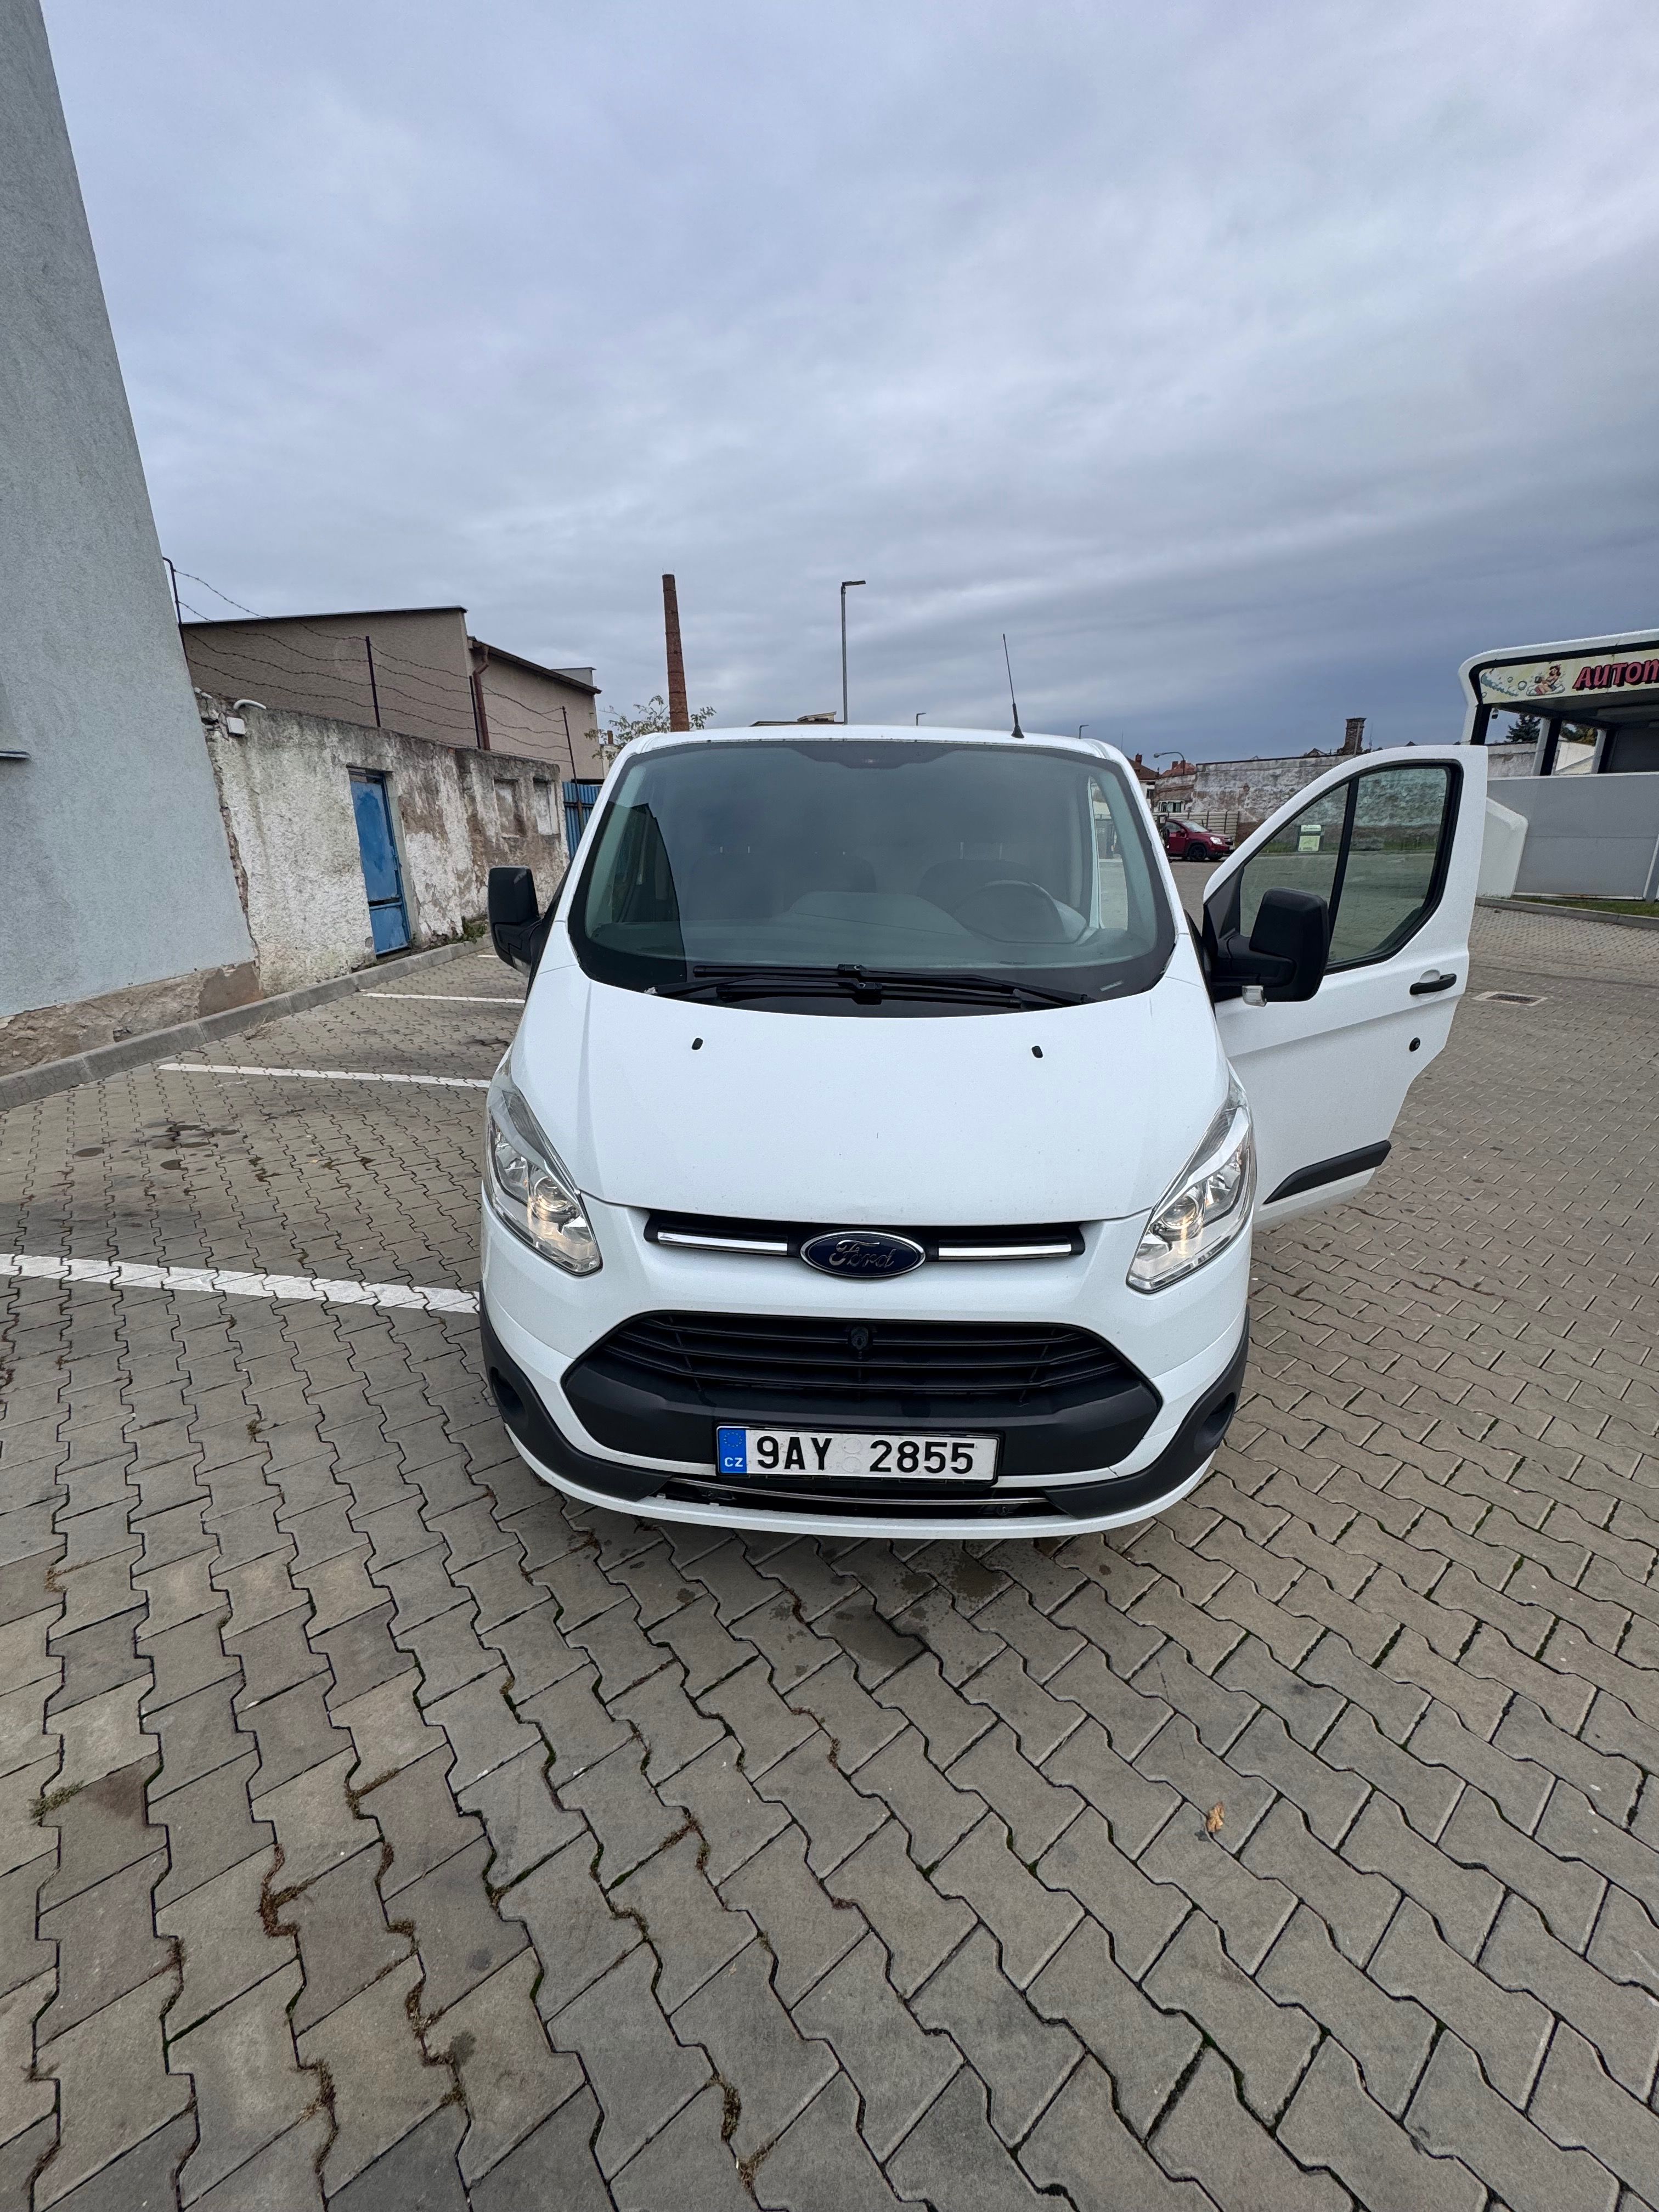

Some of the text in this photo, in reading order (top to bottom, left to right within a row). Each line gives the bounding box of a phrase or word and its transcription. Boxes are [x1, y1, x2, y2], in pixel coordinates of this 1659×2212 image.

[829, 1239, 896, 1268] Ford
[724, 1457, 743, 1468] CZ
[756, 1436, 975, 1475] 9AY 2855
